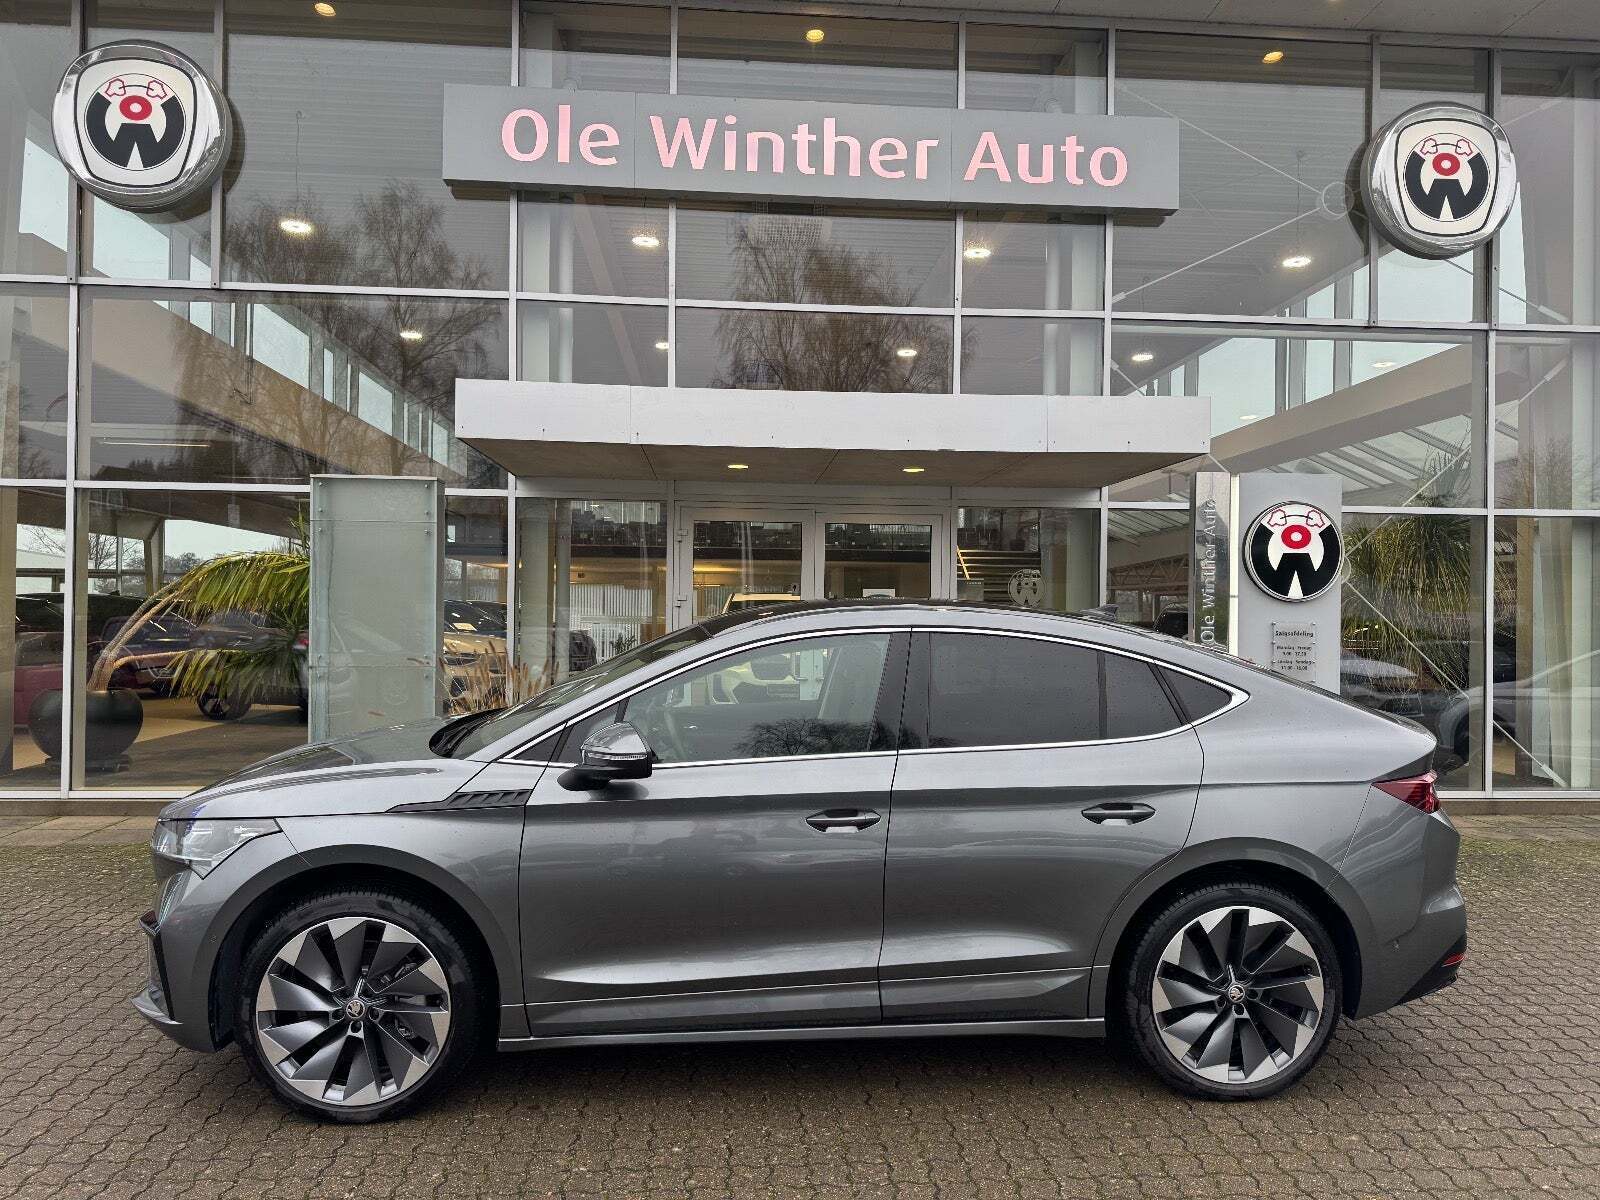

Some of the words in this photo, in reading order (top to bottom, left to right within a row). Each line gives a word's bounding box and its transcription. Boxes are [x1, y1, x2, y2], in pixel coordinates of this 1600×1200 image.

[500, 104, 620, 166] Ole
[650, 114, 939, 181] Winther
[963, 131, 1129, 188] Auto
[1202, 498, 1216, 537] Auto
[1201, 544, 1216, 608] Winther
[1201, 615, 1215, 643] Ole
